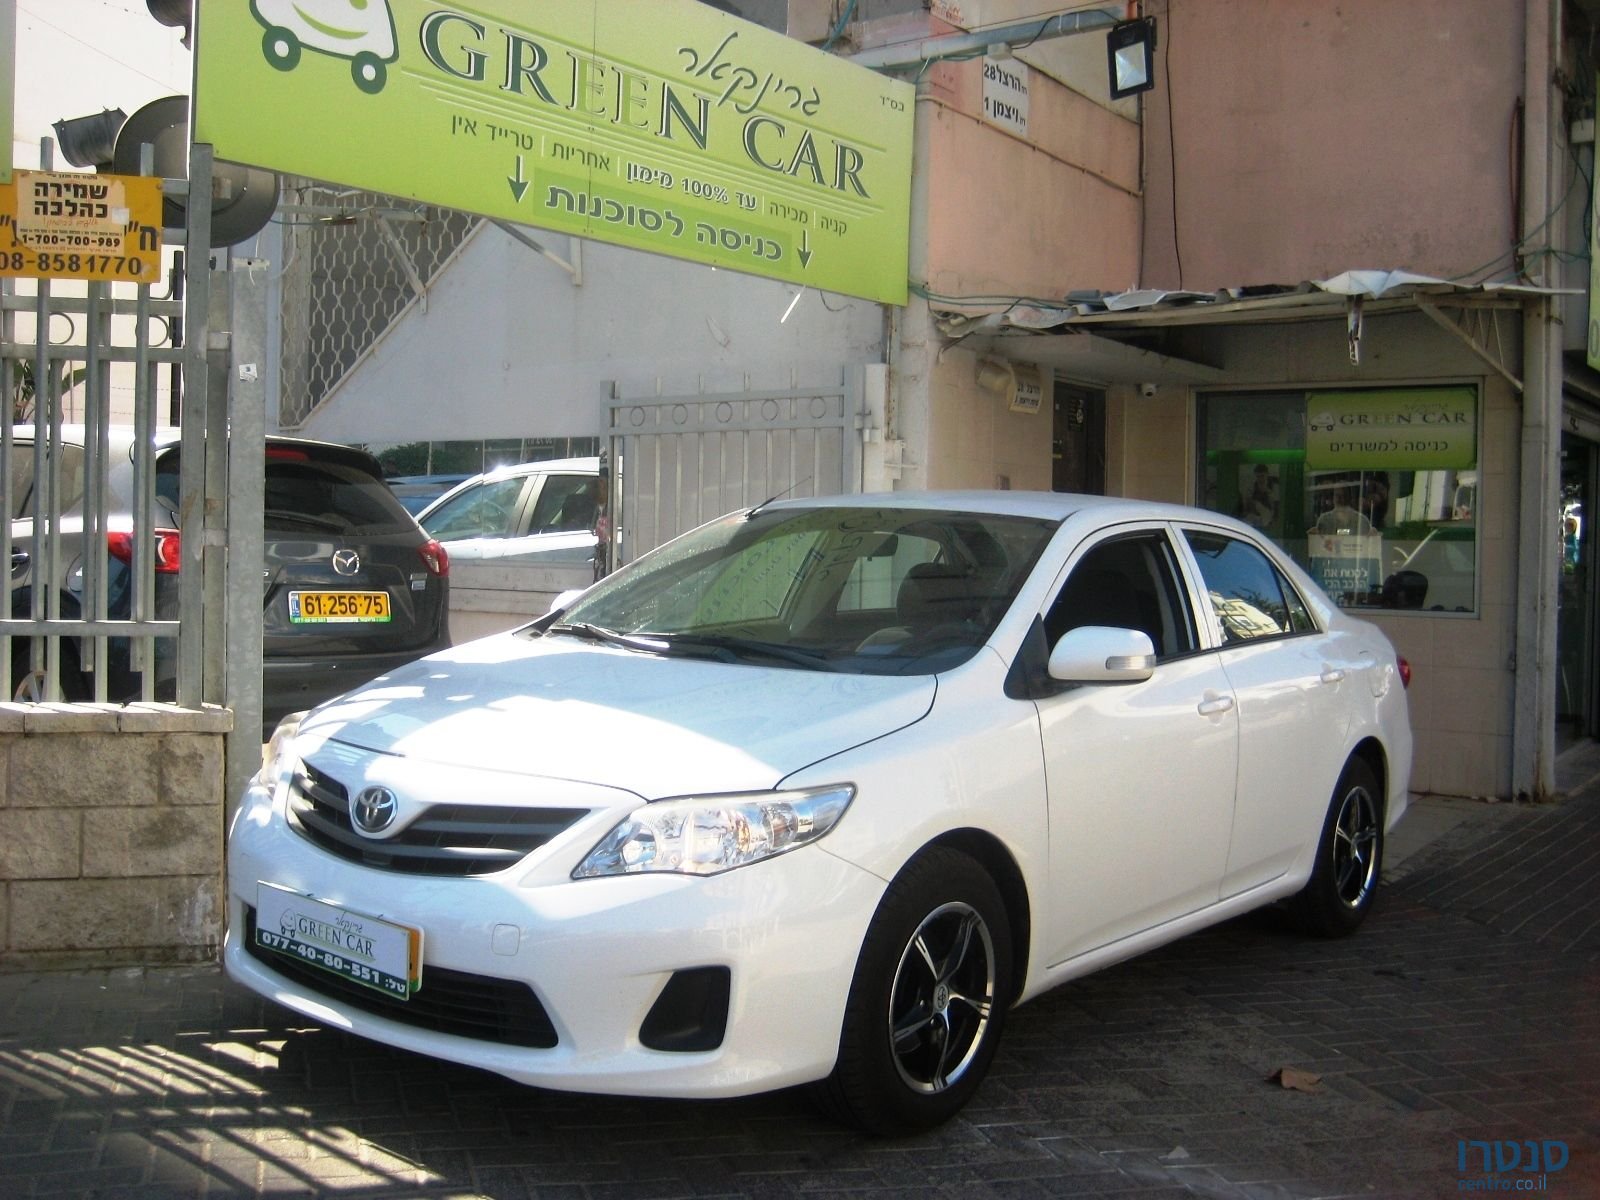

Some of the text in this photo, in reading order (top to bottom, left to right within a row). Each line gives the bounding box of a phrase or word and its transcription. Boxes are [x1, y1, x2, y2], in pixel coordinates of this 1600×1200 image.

[678, 31, 821, 116] גרינקאר
[419, 10, 871, 199] GREEN CAR
[34, 182, 109, 200] שמירה
[452, 115, 847, 237] קניה מכירה עד 100% מימון אחריות טרייד אין
[34, 200, 108, 219] כהלכה
[545, 185, 783, 261] כניסה לסוכנות
[22, 234, 121, 247] 1-700-700-989
[1423, 412, 1466, 424] CAR
[1329, 439, 1449, 453] כניסה למשרדים
[298, 917, 374, 957] GREEN CAR
[262, 931, 380, 984] 077-40-80-551
